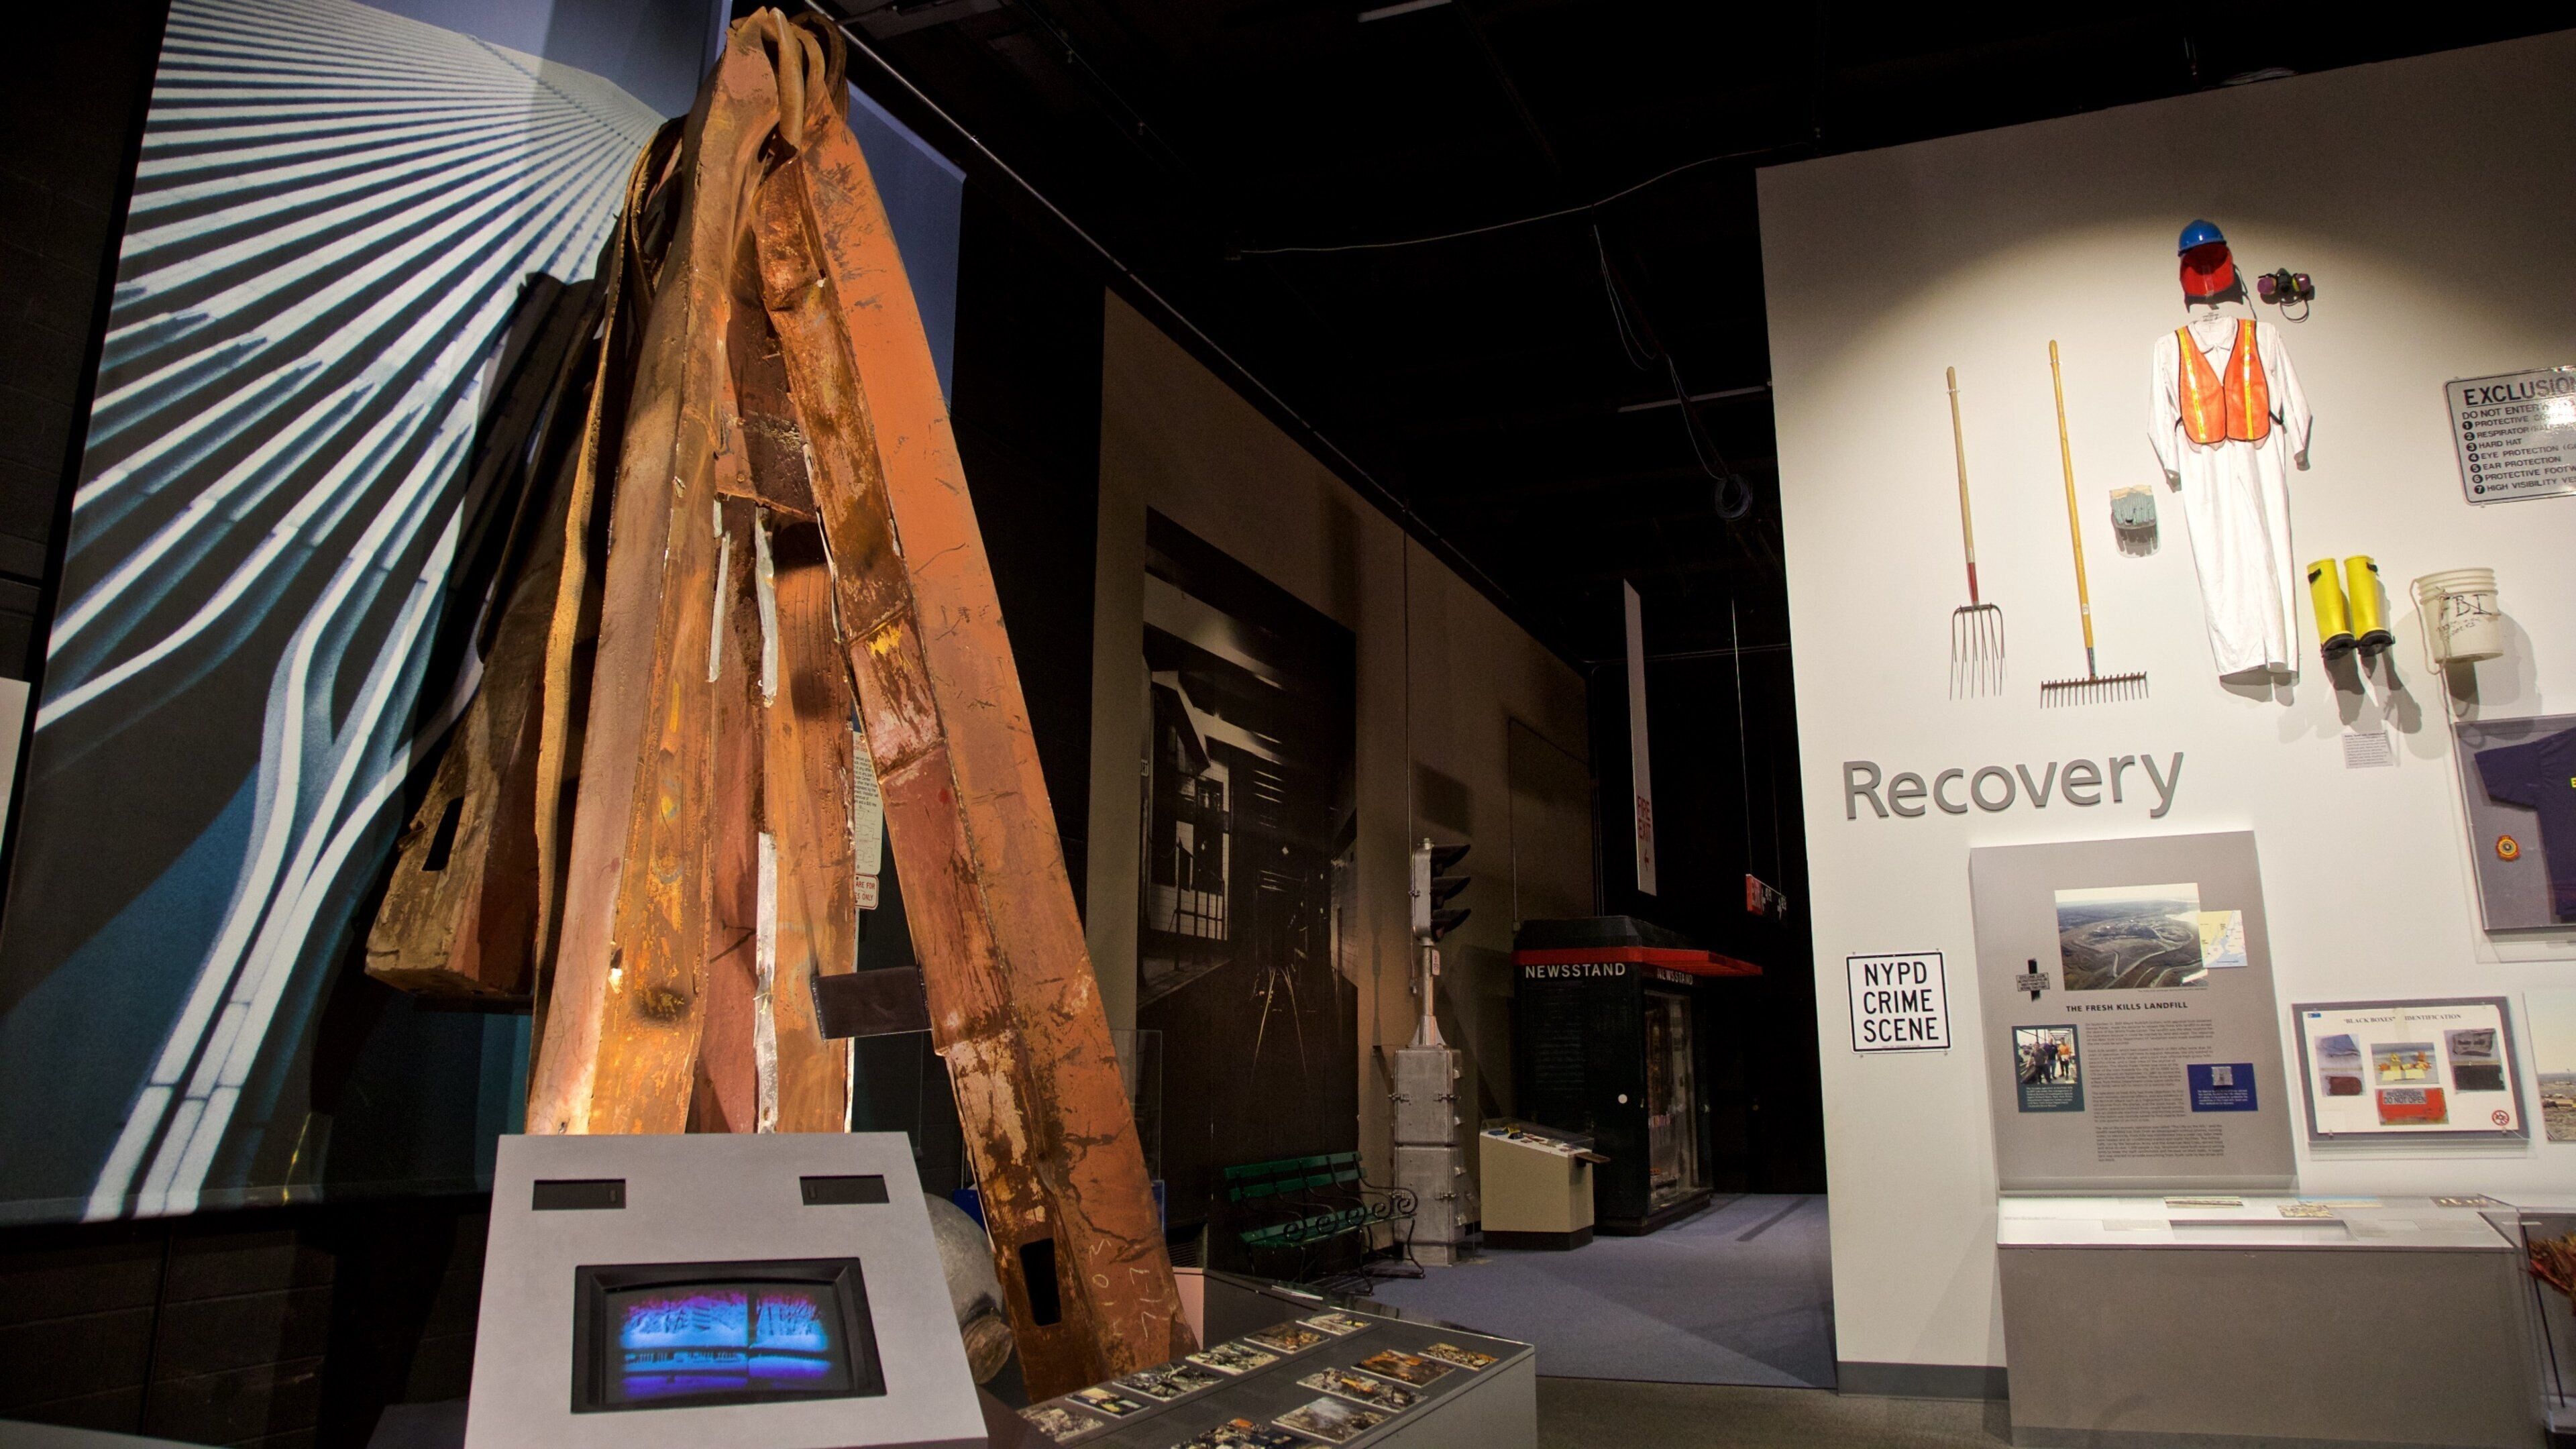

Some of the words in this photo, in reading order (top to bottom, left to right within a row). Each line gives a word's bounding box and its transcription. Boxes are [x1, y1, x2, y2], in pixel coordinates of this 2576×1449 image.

[2462, 411, 2478, 420] DO
[2480, 408, 2502, 417] NOT
[2505, 404, 2539, 415] ENTER
[2475, 416, 2528, 427] PROTECTIVE
[2477, 427, 2529, 438] RESPIRATOR
[2479, 440, 2503, 449] HARD
[2506, 438, 2522, 446] HAT
[2481, 451, 2498, 460] EYE
[2503, 445, 2559, 457] PROTECTION
[2505, 456, 2561, 468] PROTECTION
[2485, 469, 2540, 481] PROTECTIVE
[2512, 479, 2557, 489] VISIBILITY
[2440, 594, 2491, 620] FBI
[1843, 751, 2184, 820] Recovery
[1525, 963, 1626, 979] NEWSSTAND
[1657, 968, 1693, 985] NEWSSTAND
[1864, 961, 1927, 986] NYPD
[1864, 989, 1935, 1014] CRIME
[2144, 1002, 2188, 1010] LANDFILL
[1864, 1017, 1939, 1042] SCENE
